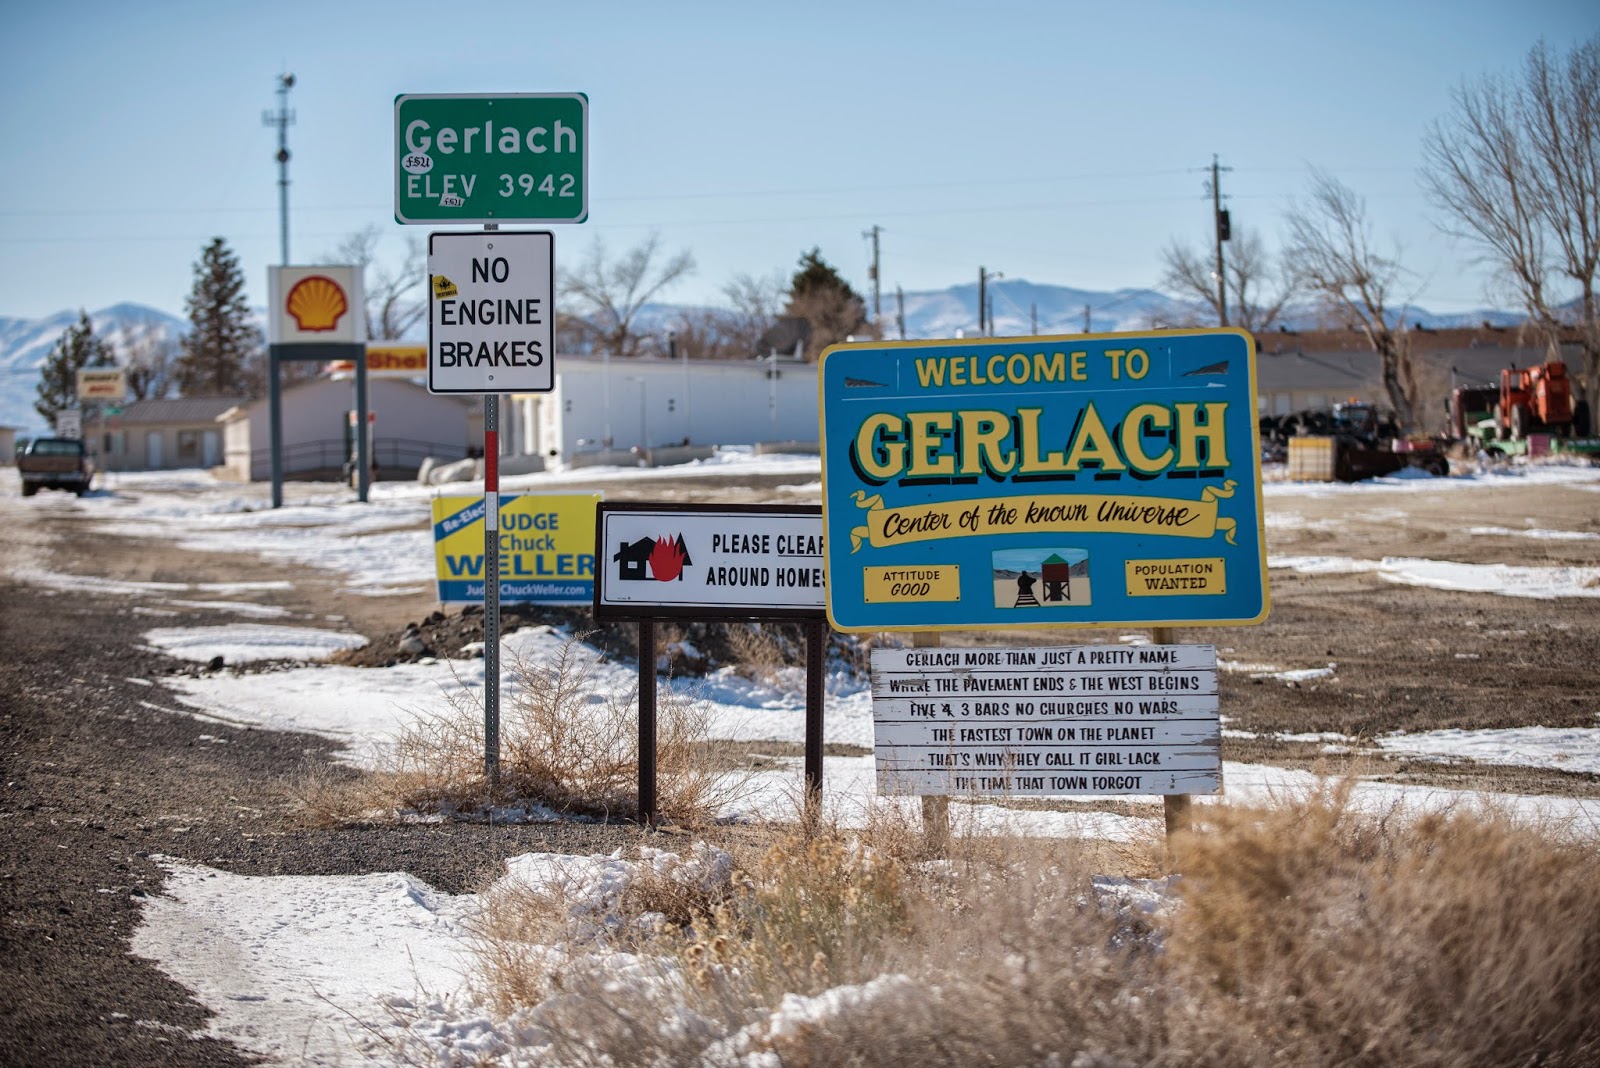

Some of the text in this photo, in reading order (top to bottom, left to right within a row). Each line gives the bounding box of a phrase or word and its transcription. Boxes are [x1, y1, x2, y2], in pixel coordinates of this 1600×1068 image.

[405, 119, 576, 154] Gerlach
[407, 173, 575, 198] ELEV 3942
[472, 257, 510, 283] NO
[441, 299, 542, 325] ENGINE
[368, 352, 428, 369] Shel
[439, 341, 544, 367] BRAKES
[914, 348, 1150, 388] WELCOME TO
[852, 402, 1231, 481] GERLACH
[442, 504, 485, 533] Re-Elec
[501, 513, 559, 531] UDGE
[883, 501, 1201, 539] Center of the known Universe
[499, 533, 556, 551] Chuck
[712, 534, 770, 554] PLEASE
[445, 554, 594, 576] WELLER
[1135, 563, 1213, 576] POPULATION
[706, 566, 769, 587] AROUND
[883, 570, 940, 581] ATTITUDE
[1144, 577, 1207, 590] WANTED
[466, 584, 586, 596] JudChuckWeller.com
[891, 582, 930, 596] GOOD
[906, 650, 1177, 666] GERLACH MORE THAN JUST A PRETTY NAME
[935, 678, 959, 692] THE
[963, 677, 1029, 692] PAVEMENT
[1033, 677, 1064, 691] ENDS
[1069, 680, 1077, 691] &
[1080, 677, 1103, 690] THE
[1108, 676, 1144, 690] WEST
[1149, 676, 1199, 690] BEGINS
[961, 703, 970, 716] 3
[975, 703, 1010, 716] BARS
[1015, 703, 1034, 716] NO
[1040, 702, 1108, 716] CHURCHES
[1114, 702, 1133, 715] NO
[1139, 701, 1178, 714] WARS
[931, 727, 1156, 742] THE FASTEST TOWN ON THE PLANET
[928, 752, 1161, 766] THAT'S WHY THEY CALL IT GIRL-LACK
[1015, 777, 1045, 790] THAT
[1049, 776, 1087, 790] TOWN
[1092, 776, 1142, 790] FORGOT
